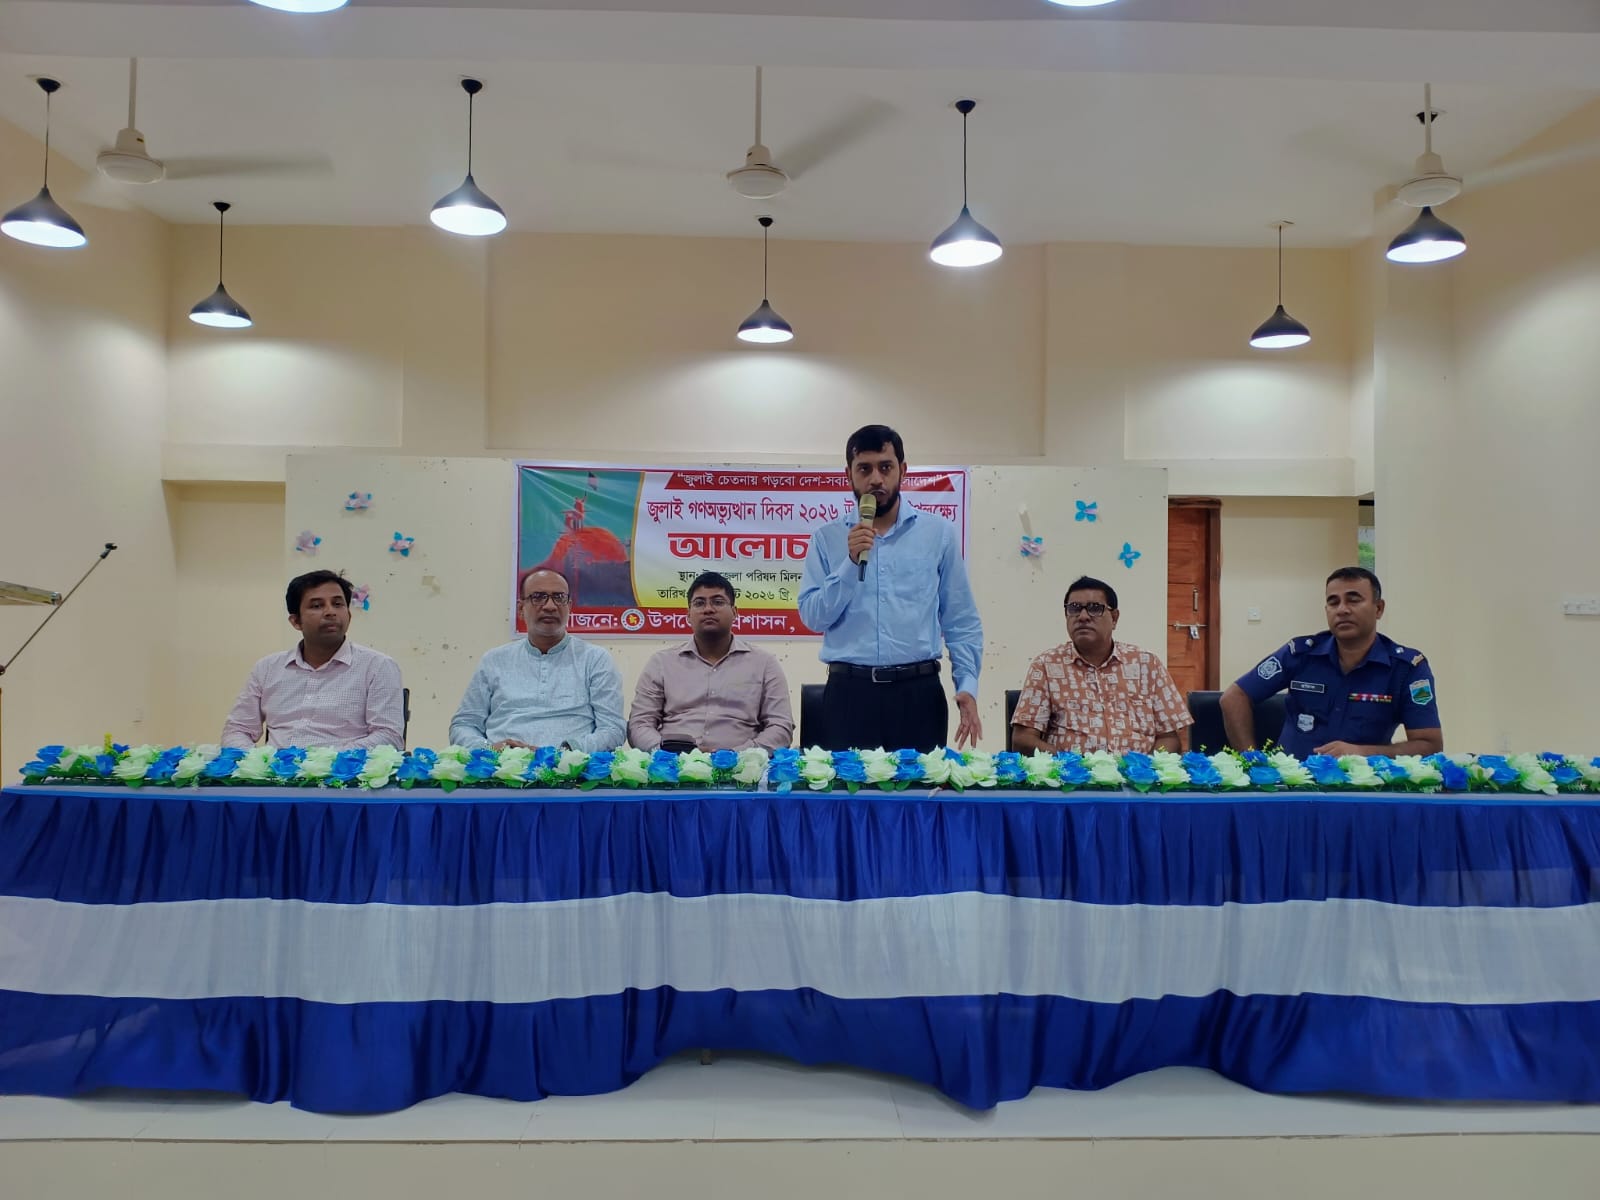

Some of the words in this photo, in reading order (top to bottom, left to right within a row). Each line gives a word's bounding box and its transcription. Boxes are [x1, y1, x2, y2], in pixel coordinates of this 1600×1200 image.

[719, 475, 759, 487] চেতনায়
[762, 475, 795, 488] গড়বো
[647, 496, 684, 525] জুলাই
[760, 496, 794, 521] দিবস
[799, 503, 839, 523] ২০২৬
[668, 533, 811, 560] আলোচ
[746, 569, 777, 582] পরিষদ
[745, 590, 775, 601] ২০২৬
